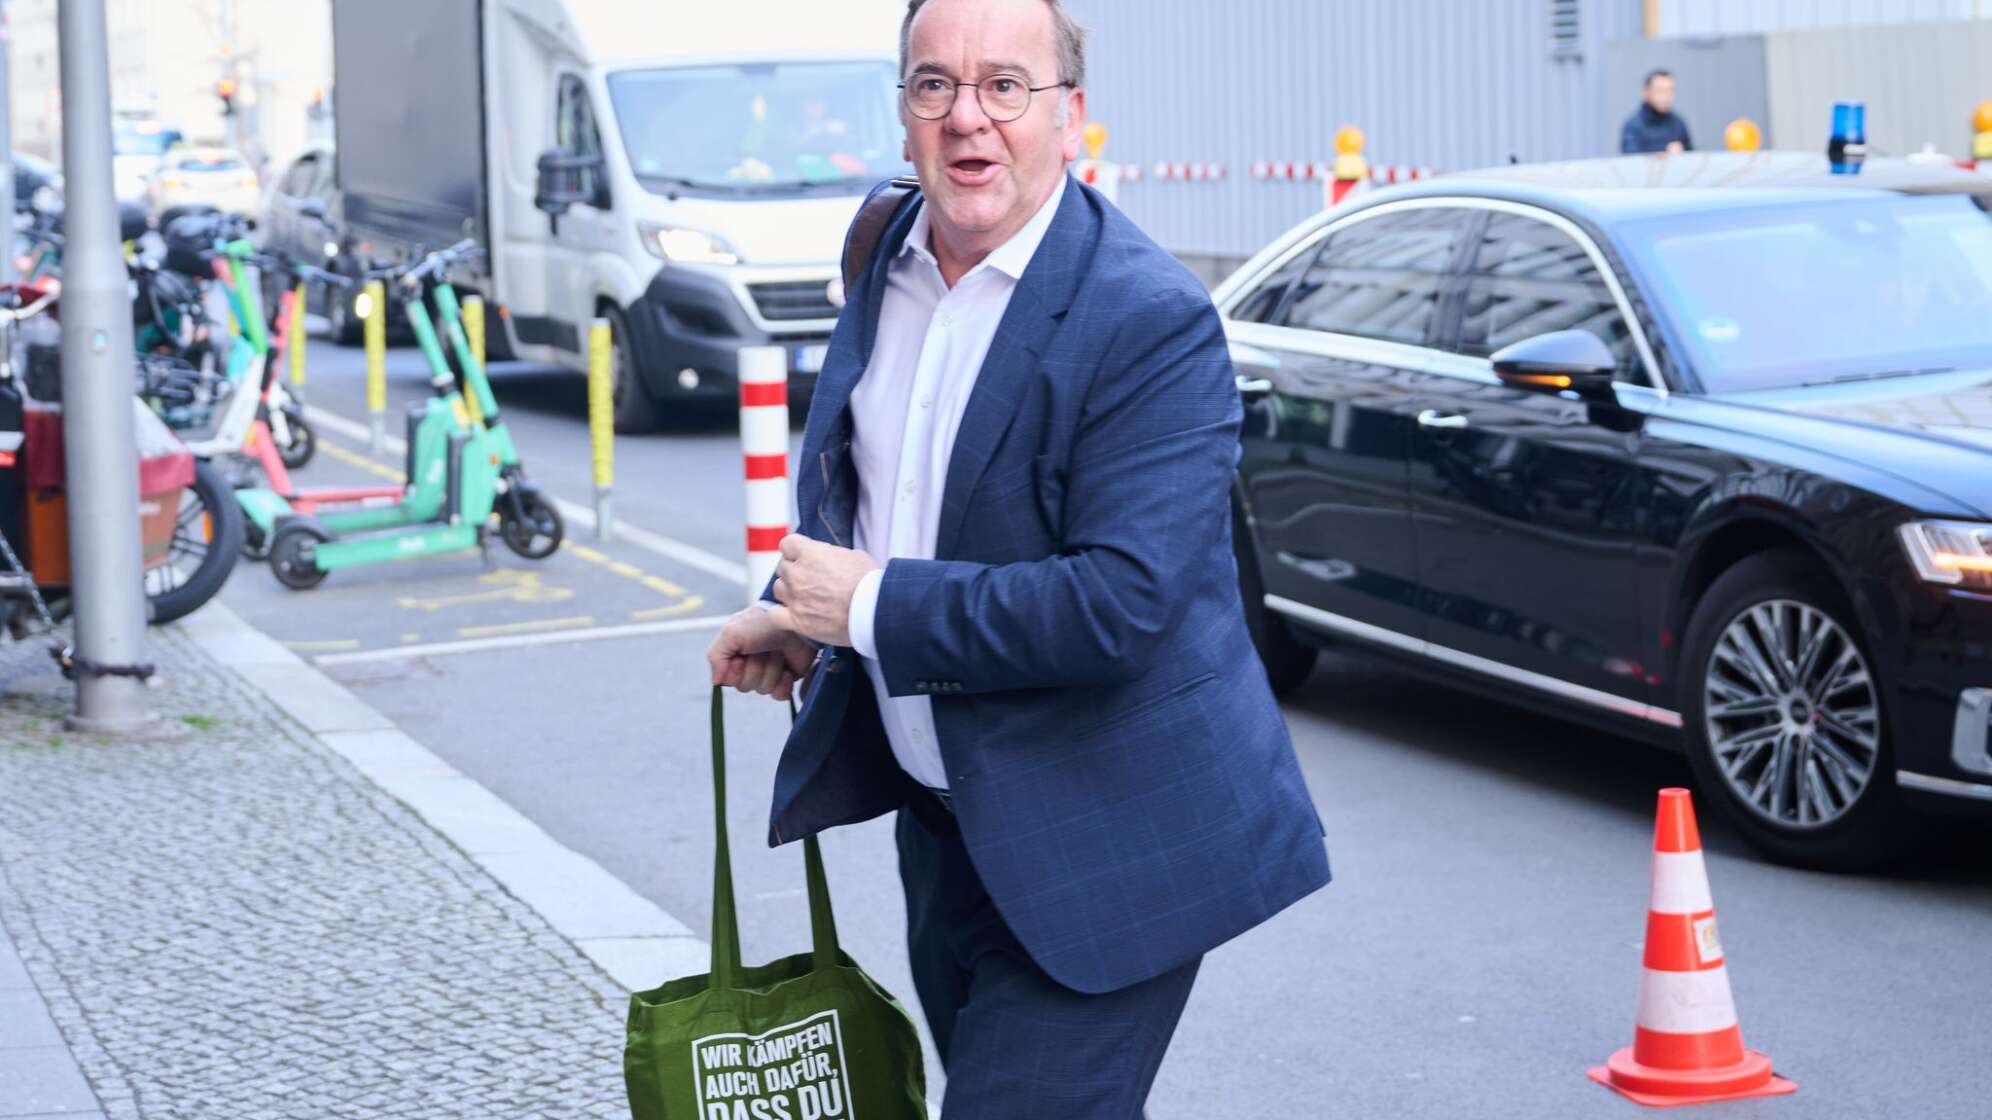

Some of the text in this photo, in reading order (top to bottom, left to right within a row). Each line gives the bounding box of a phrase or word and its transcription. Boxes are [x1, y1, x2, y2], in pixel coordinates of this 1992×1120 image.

[701, 1022, 833, 1069] WIR KÄMPFEN
[706, 1051, 838, 1099] AUCH DAFÜR,
[797, 1078, 843, 1120] DU
